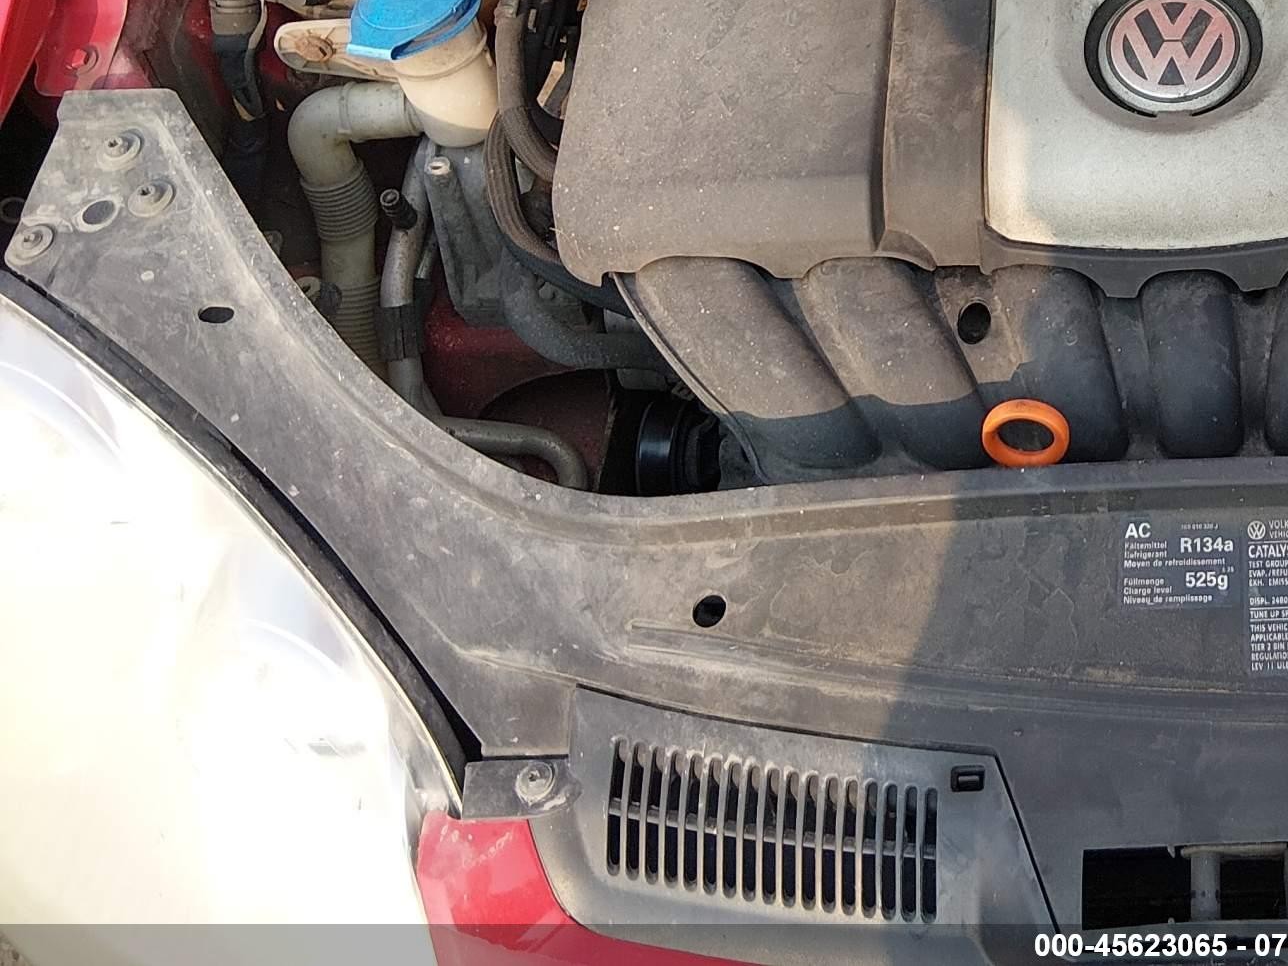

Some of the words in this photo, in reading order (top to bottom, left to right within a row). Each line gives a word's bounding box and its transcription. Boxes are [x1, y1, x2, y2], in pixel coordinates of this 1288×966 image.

[1124, 522, 1151, 539] AC
[1180, 536, 1234, 553] R134a
[1124, 550, 1167, 560] Refrigerant
[1124, 559, 1150, 569] Moyen
[1153, 559, 1163, 567] de
[1165, 557, 1225, 567] refroidissement
[1248, 560, 1263, 568] TEST
[1265, 559, 1288, 568] GROUP
[1123, 577, 1164, 587] Füllmenge
[1185, 571, 1229, 591] 525g
[1248, 578, 1265, 587] EXH.
[1123, 586, 1151, 596] Charge
[1153, 585, 1172, 594] level
[1123, 595, 1151, 604] Niveau
[1153, 595, 1163, 603] de
[1165, 594, 1213, 604] remplissage
[1249, 596, 1270, 606] DISPL.
[1249, 610, 1268, 619] TUNE
[1270, 609, 1280, 618] UP
[1250, 623, 1266, 633] THIS
[1251, 632, 1288, 642] APPLICABLE
[1251, 642, 1265, 651] TIER
[1267, 642, 1271, 651] 2
[1273, 641, 1285, 650] BIN
[1251, 662, 1264, 671] LEV
